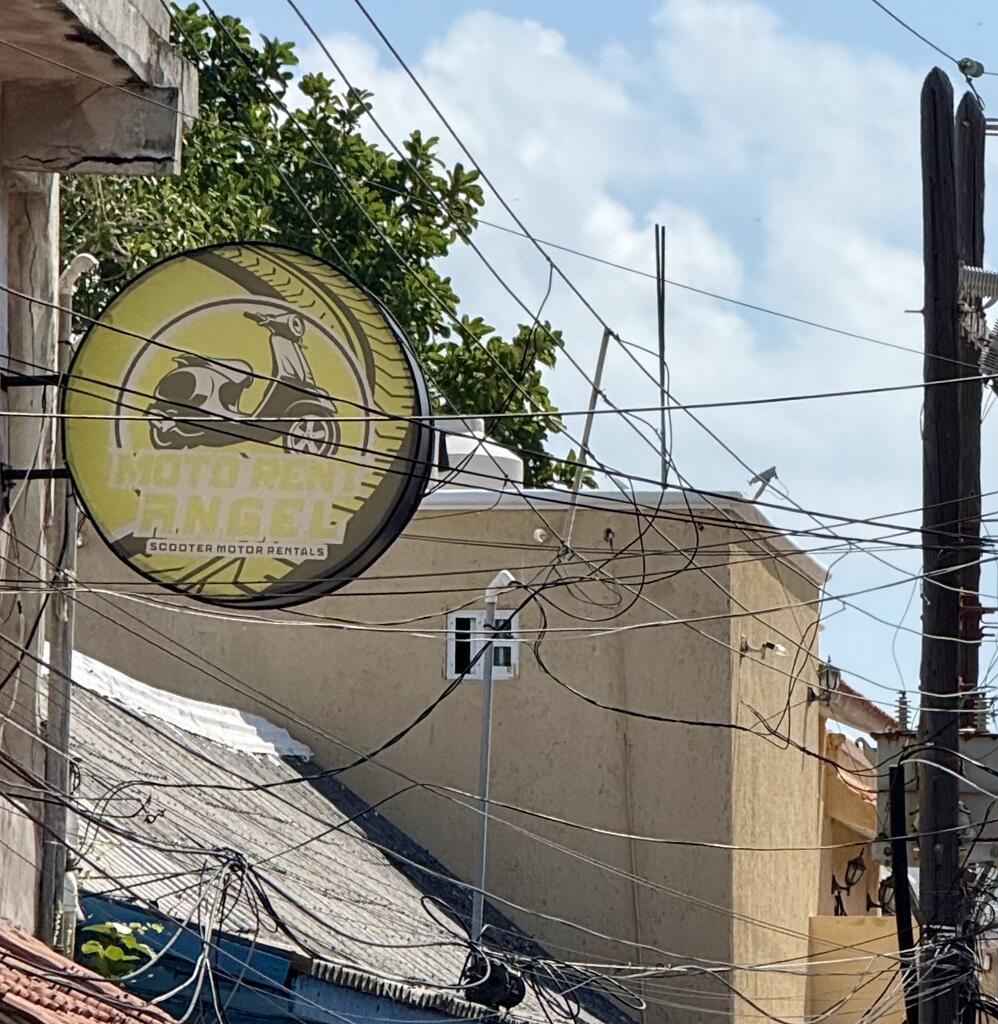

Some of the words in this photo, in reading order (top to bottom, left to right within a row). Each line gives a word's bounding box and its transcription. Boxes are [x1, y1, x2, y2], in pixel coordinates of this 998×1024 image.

[113, 453, 240, 490] MOTO
[250, 457, 362, 495] RENT
[139, 493, 341, 541] ANGEL
[149, 541, 213, 553] SCOOTER
[216, 543, 263, 555] MOTOR
[267, 545, 325, 557] RENTALS
